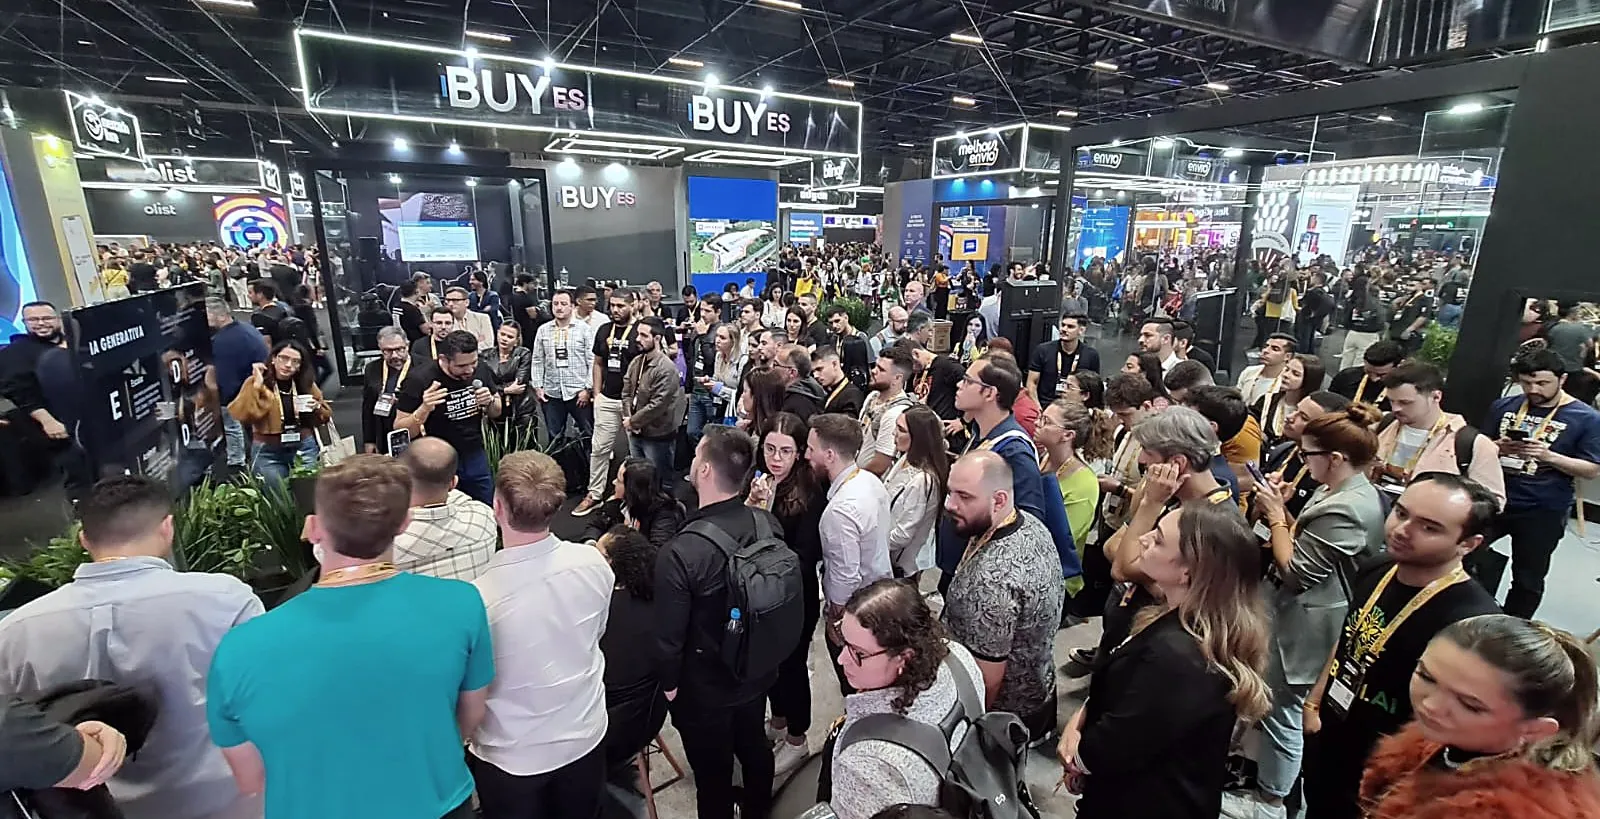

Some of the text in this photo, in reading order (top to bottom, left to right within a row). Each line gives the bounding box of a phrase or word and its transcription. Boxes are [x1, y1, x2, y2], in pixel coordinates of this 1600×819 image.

[968, 150, 998, 165] envio
[1093, 152, 1121, 166] envio
[144, 161, 198, 183] olist
[143, 203, 177, 217] olist
[88, 325, 145, 356] IA GENERATIVA
[109, 390, 123, 421] E
